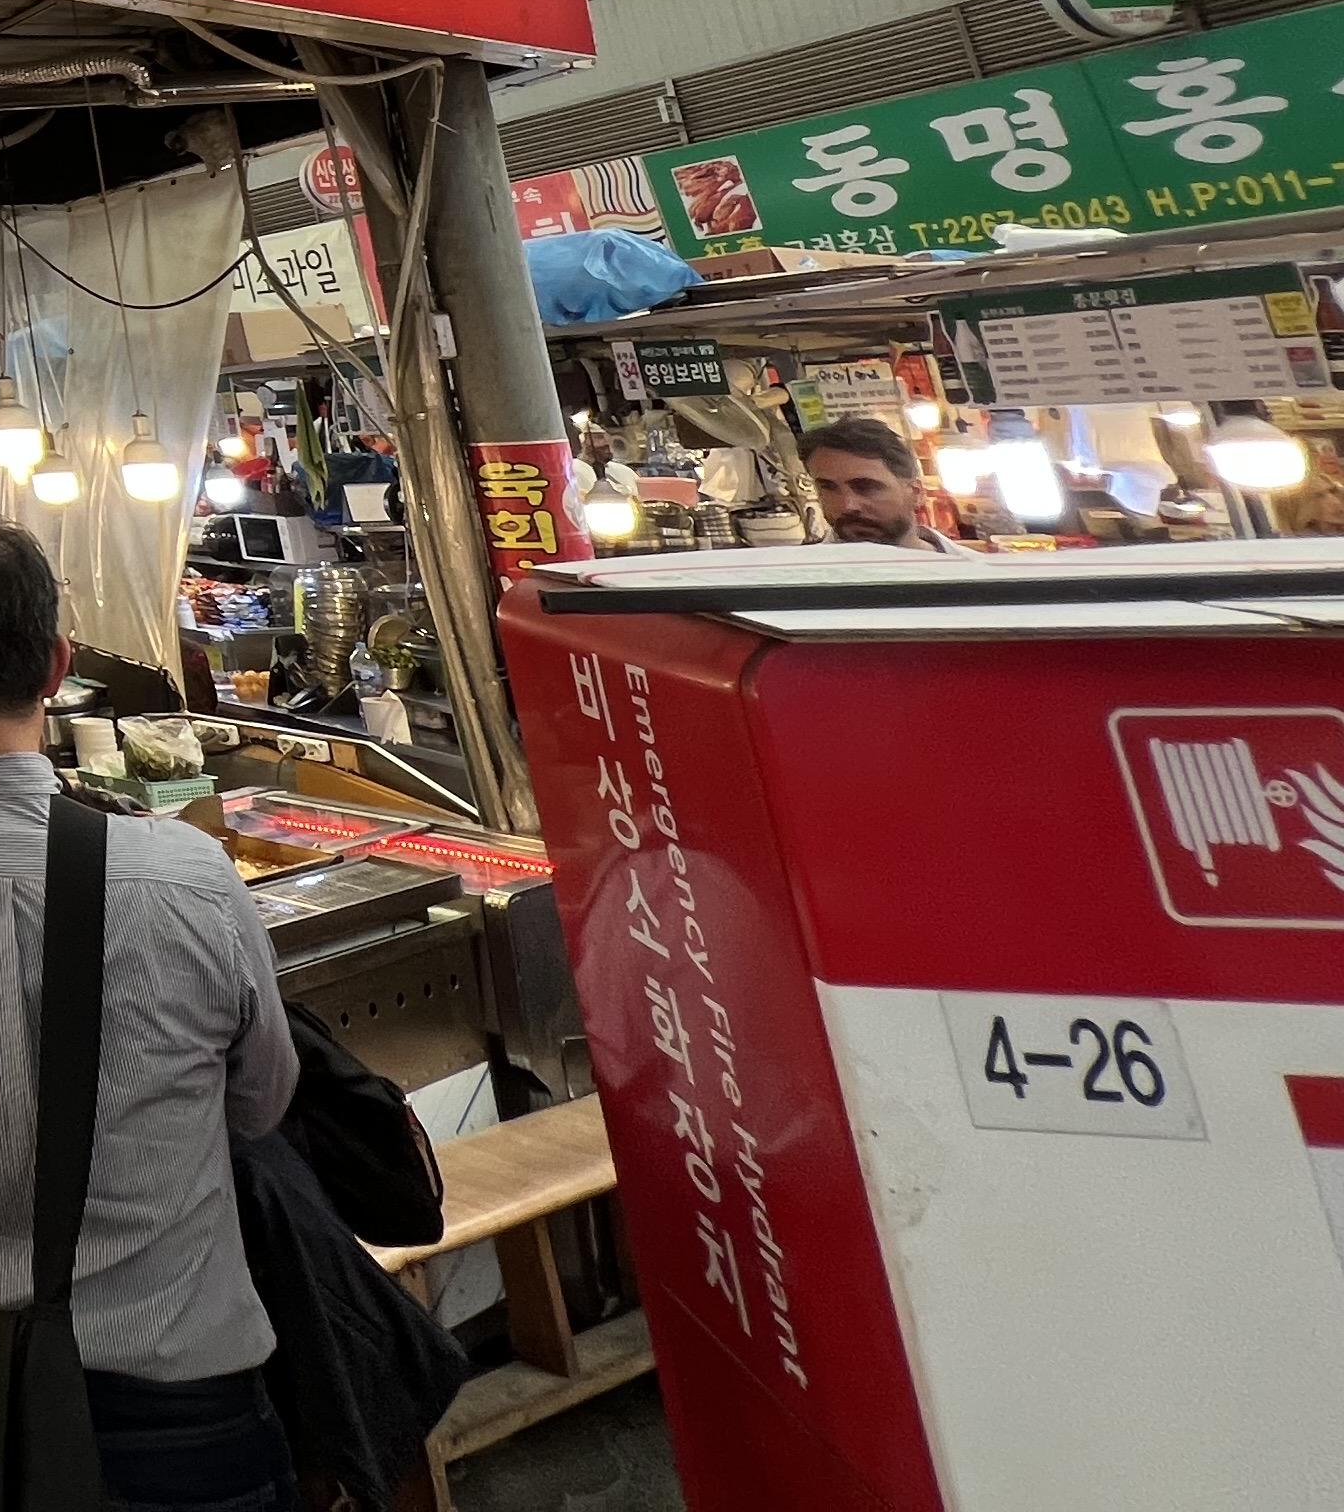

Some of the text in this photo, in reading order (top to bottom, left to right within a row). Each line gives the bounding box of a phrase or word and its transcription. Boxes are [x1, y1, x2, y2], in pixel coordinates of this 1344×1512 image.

[792, 57, 1344, 217] 동명홍
[620, 362, 640, 379] 34
[644, 361, 721, 386] 영암보리밥
[569, 653, 752, 1339] 비상소화장치
[624, 662, 808, 1391] Emergency Fire Hydrant
[985, 1014, 1165, 1107] 4-26
